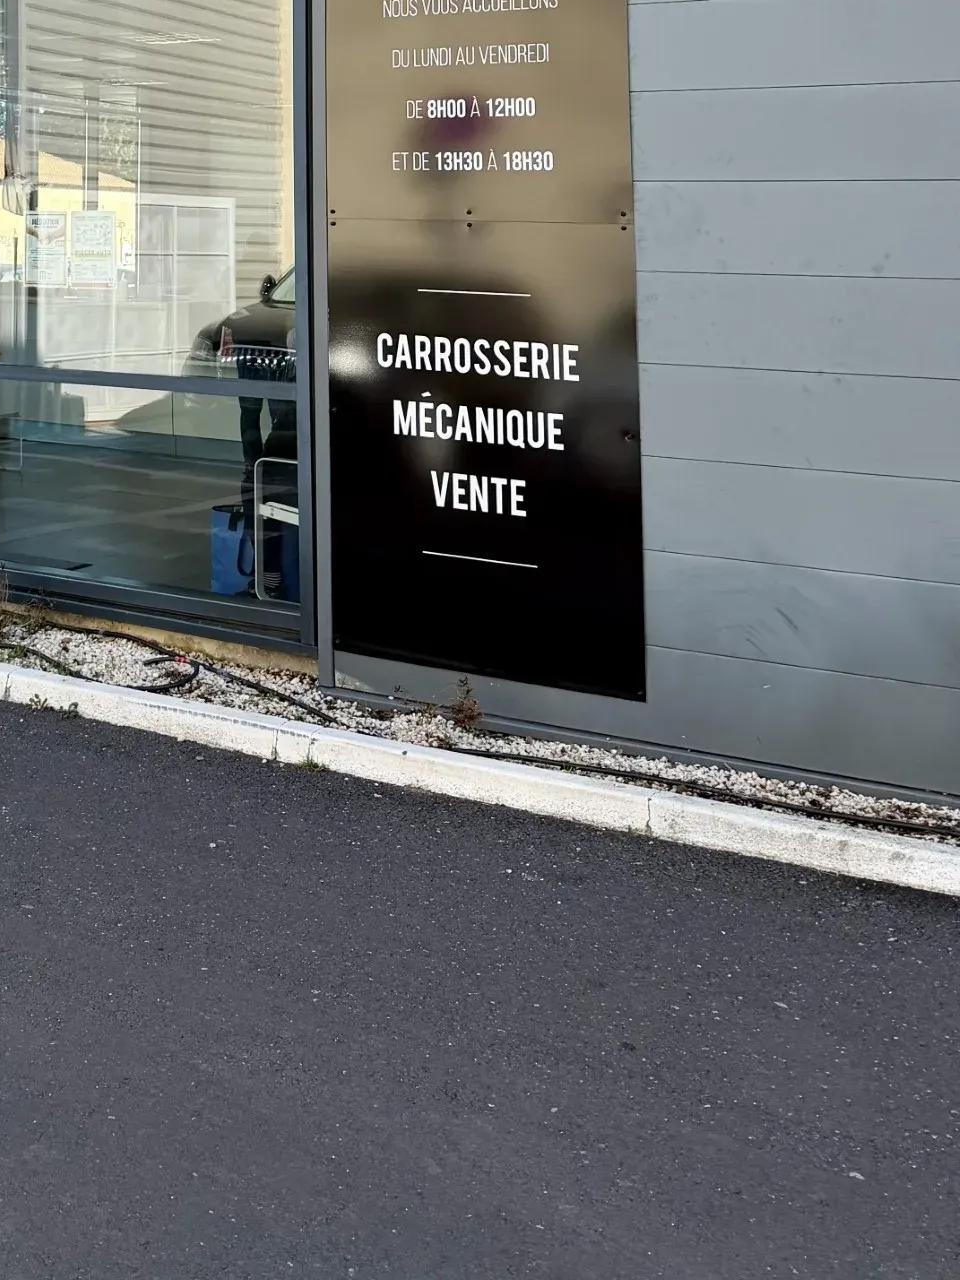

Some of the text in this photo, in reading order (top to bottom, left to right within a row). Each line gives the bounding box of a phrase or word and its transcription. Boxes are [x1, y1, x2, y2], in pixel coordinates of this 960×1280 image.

[391, 42, 550, 69] DU LUNDI AU VENDREDI
[406, 95, 536, 119] DE 8H00 À 12H00
[392, 148, 554, 172] ET DE 13H30 À 18H30
[376, 332, 580, 382] CARROSSERIE
[392, 390, 565, 451] MÉCANIQUE
[430, 469, 527, 518] VENTE
